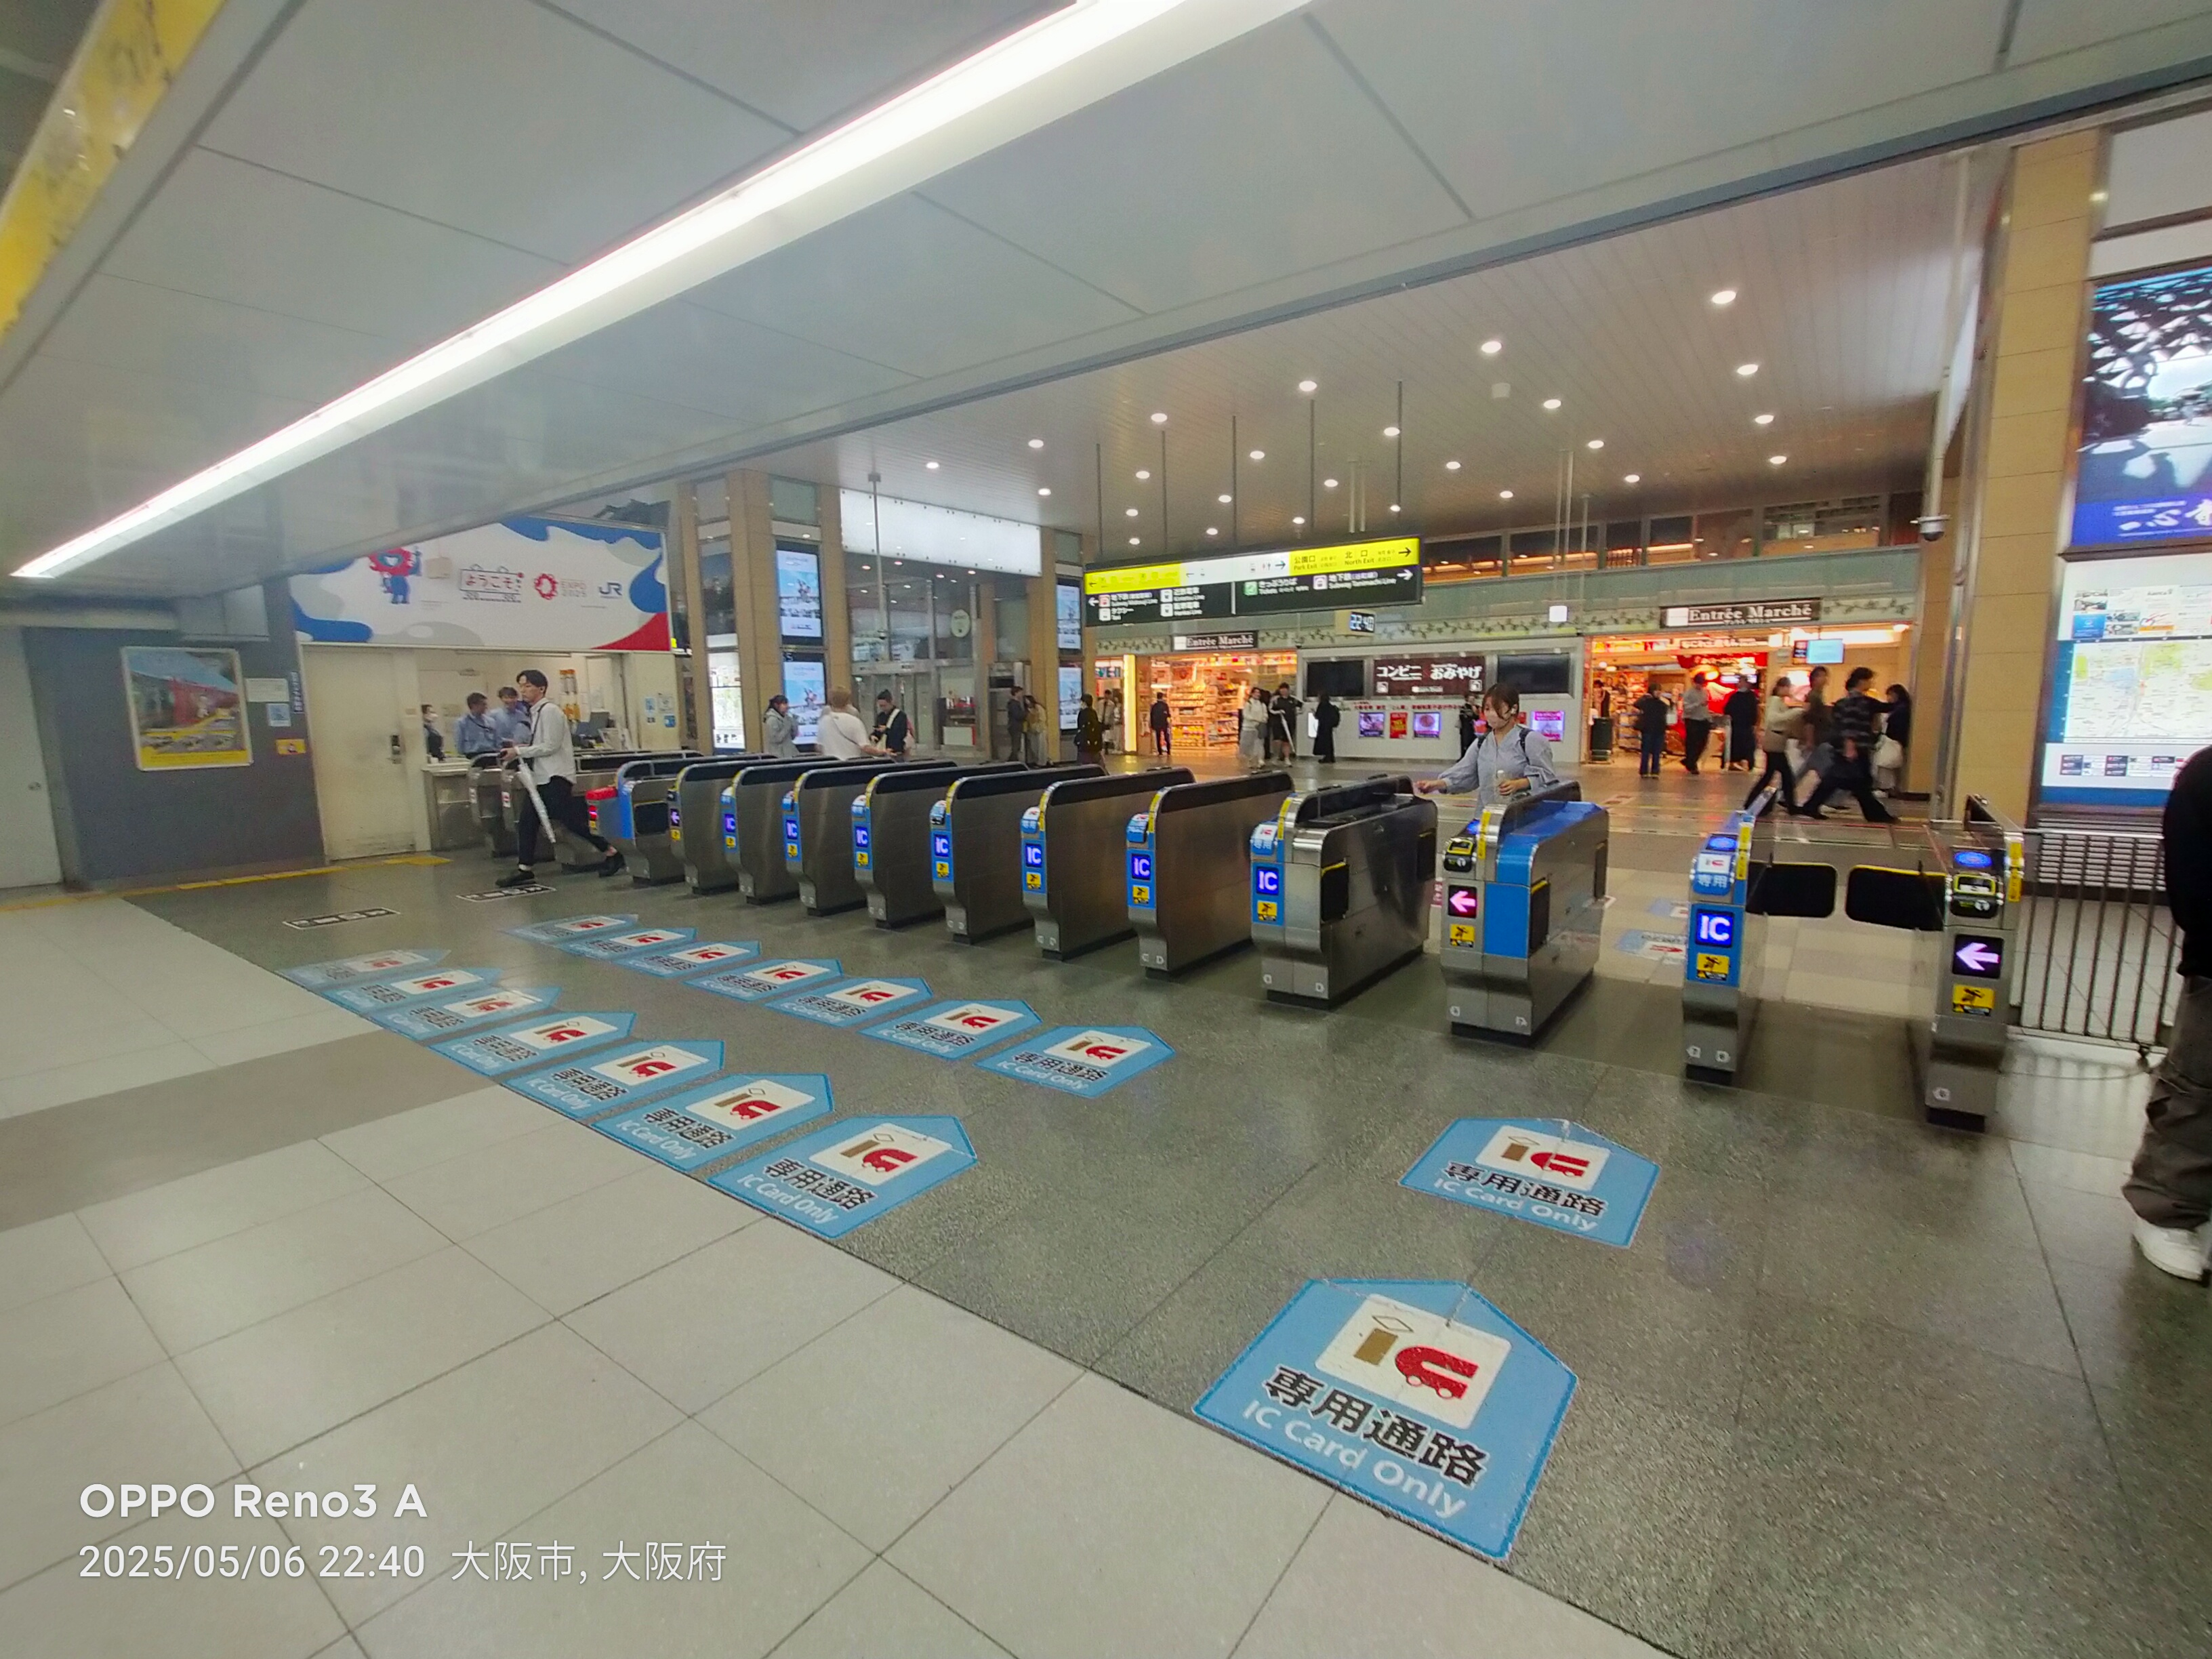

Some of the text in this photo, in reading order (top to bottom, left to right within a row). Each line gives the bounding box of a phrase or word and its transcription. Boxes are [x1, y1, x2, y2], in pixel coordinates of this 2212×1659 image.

[598, 581, 622, 596] JR
[1688, 608, 1742, 622] Entrée
[1747, 603, 1813, 619] Marché
[1187, 635, 1254, 647] Entrée Marché
[1376, 665, 1483, 680] コンビニ おみやげ
[724, 815, 736, 831] IC
[786, 821, 798, 838] IC
[856, 829, 868, 845] IC
[935, 839, 949, 855] IC
[1027, 846, 1042, 865] IC
[1134, 858, 1150, 877] IC
[1258, 871, 1277, 891] IC
[1700, 915, 1730, 941] IC
[1012, 1051, 1111, 1082] 専用通路
[643, 1107, 737, 1150] 専用通路
[616, 1120, 697, 1160] IC Card Only
[763, 1157, 878, 1212] 専用通路
[1441, 1162, 1608, 1217] 専用通路
[737, 1173, 839, 1224] IC Card Only
[1433, 1178, 1599, 1232] IC Card Only
[1263, 1365, 1489, 1489] 専用通路
[1242, 1399, 1467, 1519] IC Card Only
